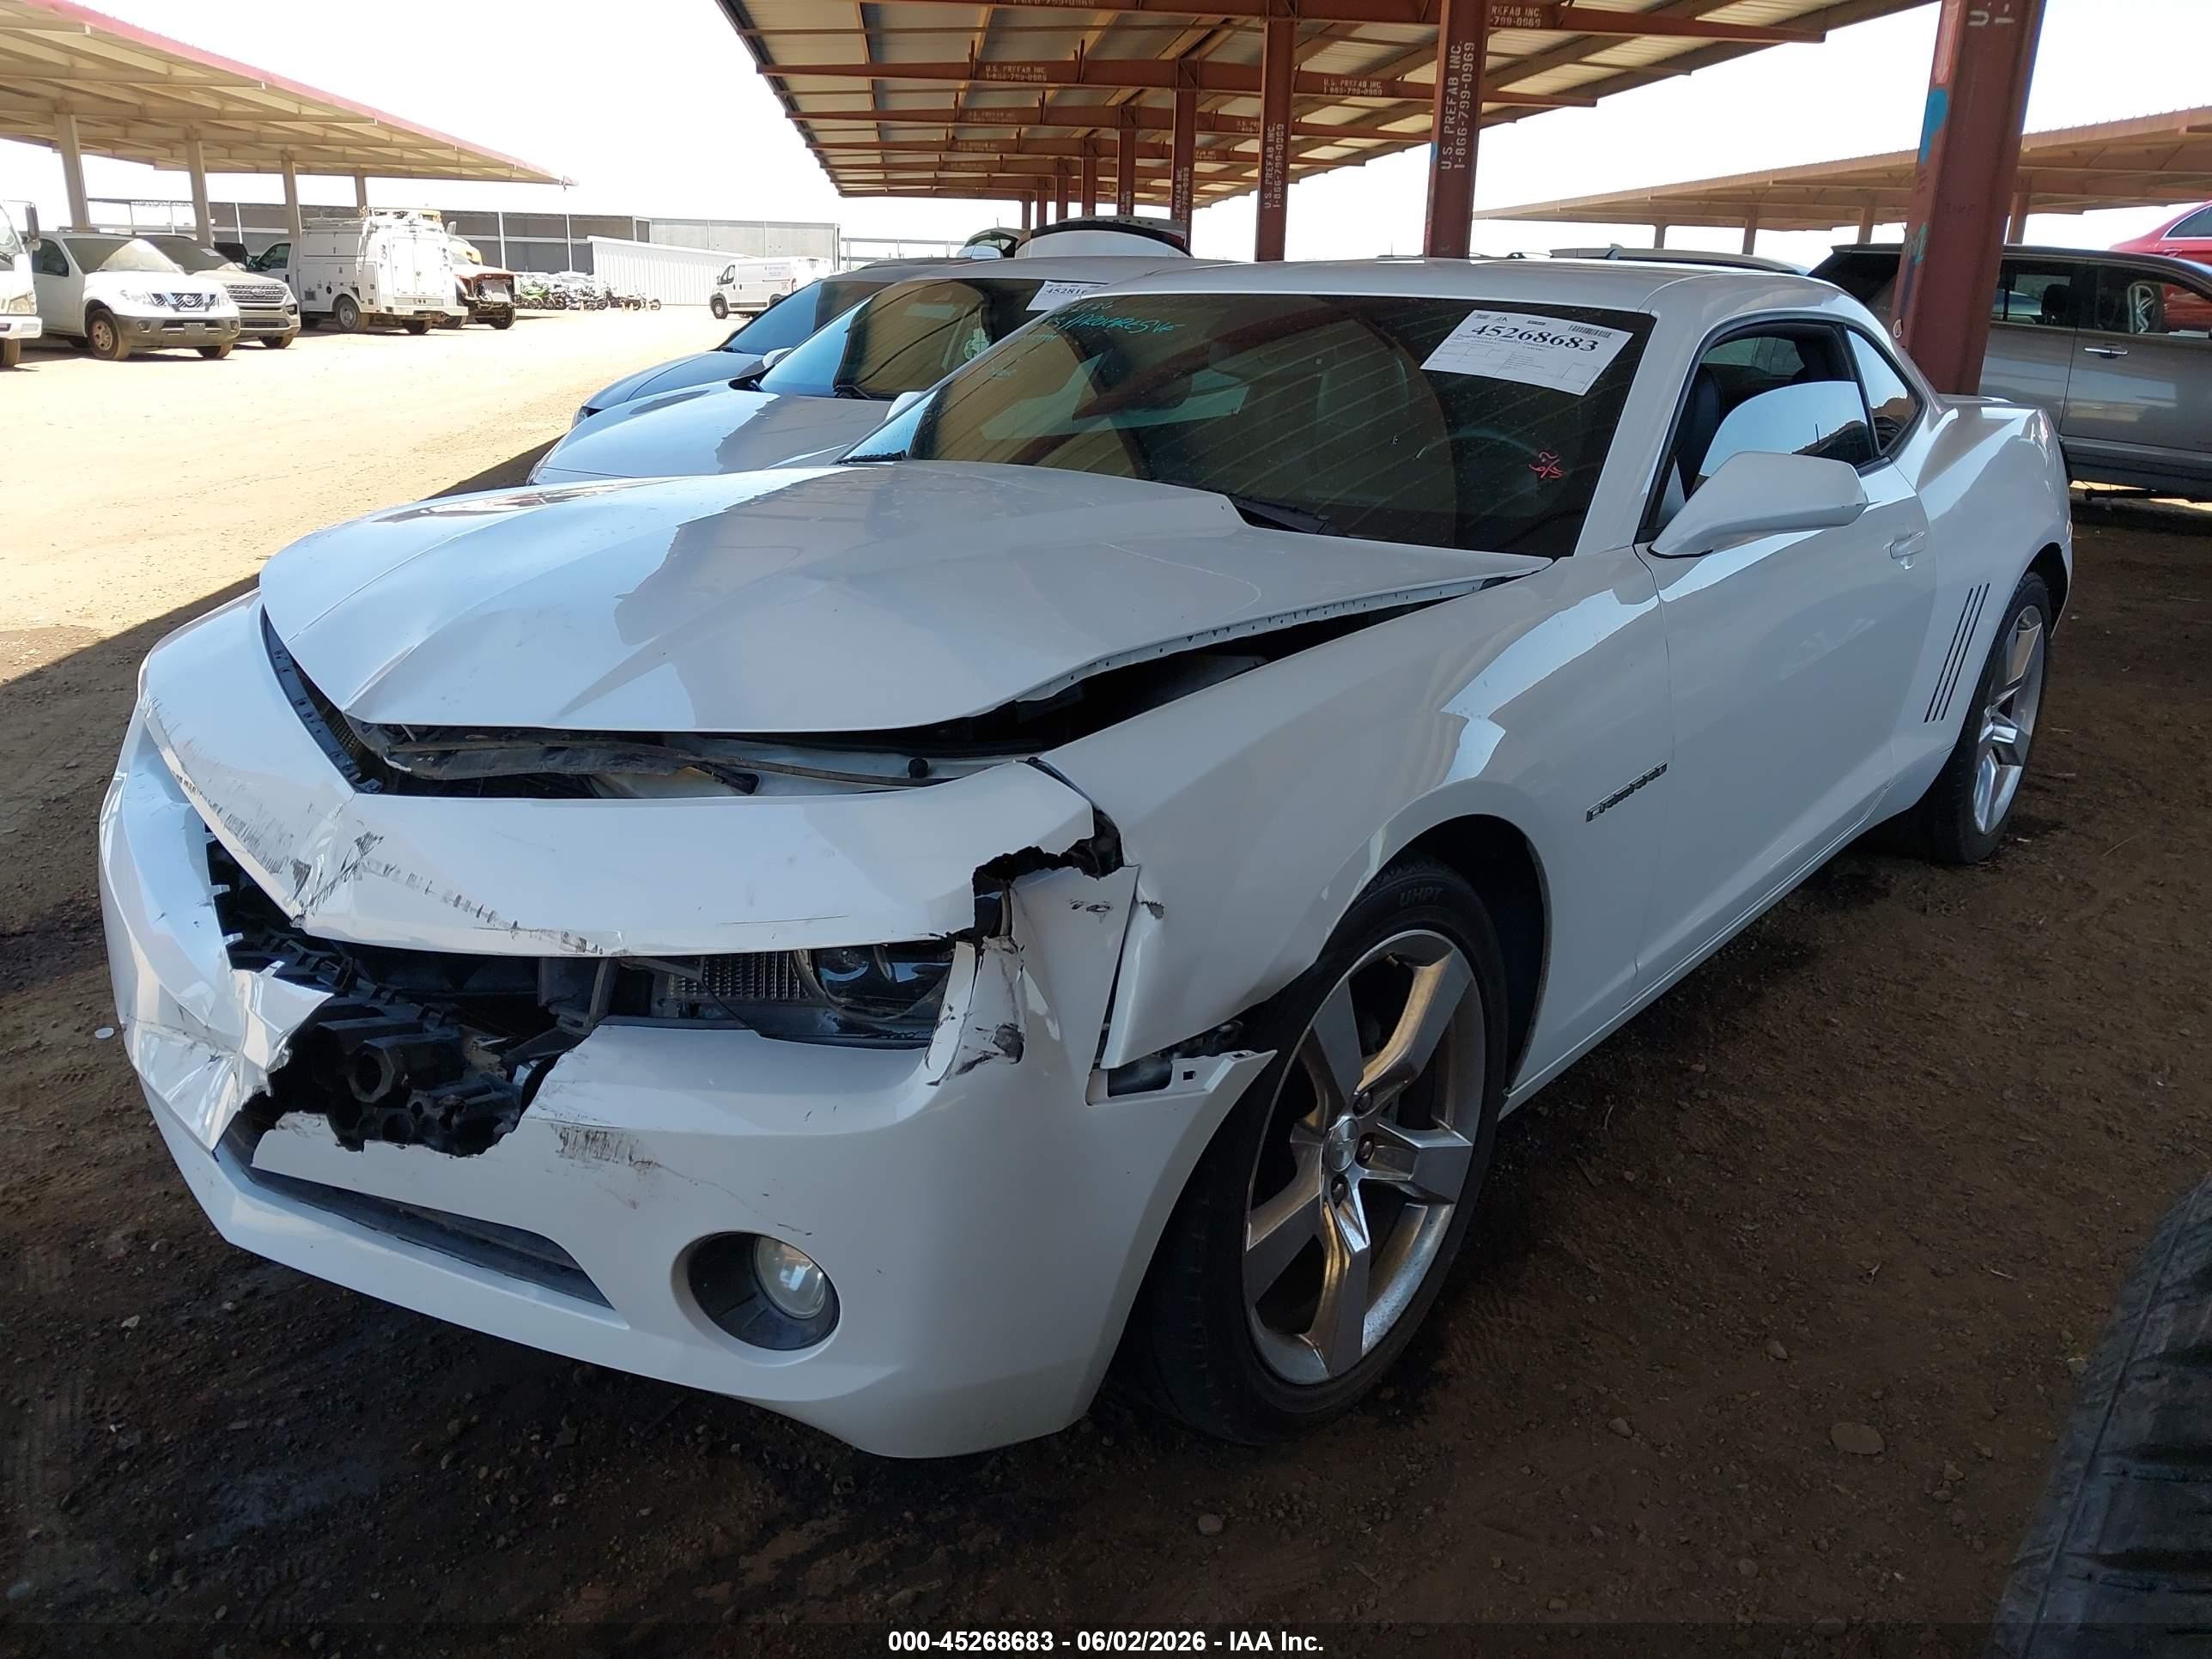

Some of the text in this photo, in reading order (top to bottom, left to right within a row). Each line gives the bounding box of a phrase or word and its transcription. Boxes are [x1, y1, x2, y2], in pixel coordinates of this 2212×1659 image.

[1492, 5, 1521, 16] REFAB
[1440, 40, 1462, 170] U.S. PREFAB INC.
[1454, 42, 1475, 169] 1-866-799-0969
[1265, 147, 1274, 185] PREFAB
[1471, 324, 1599, 352] 45268683
